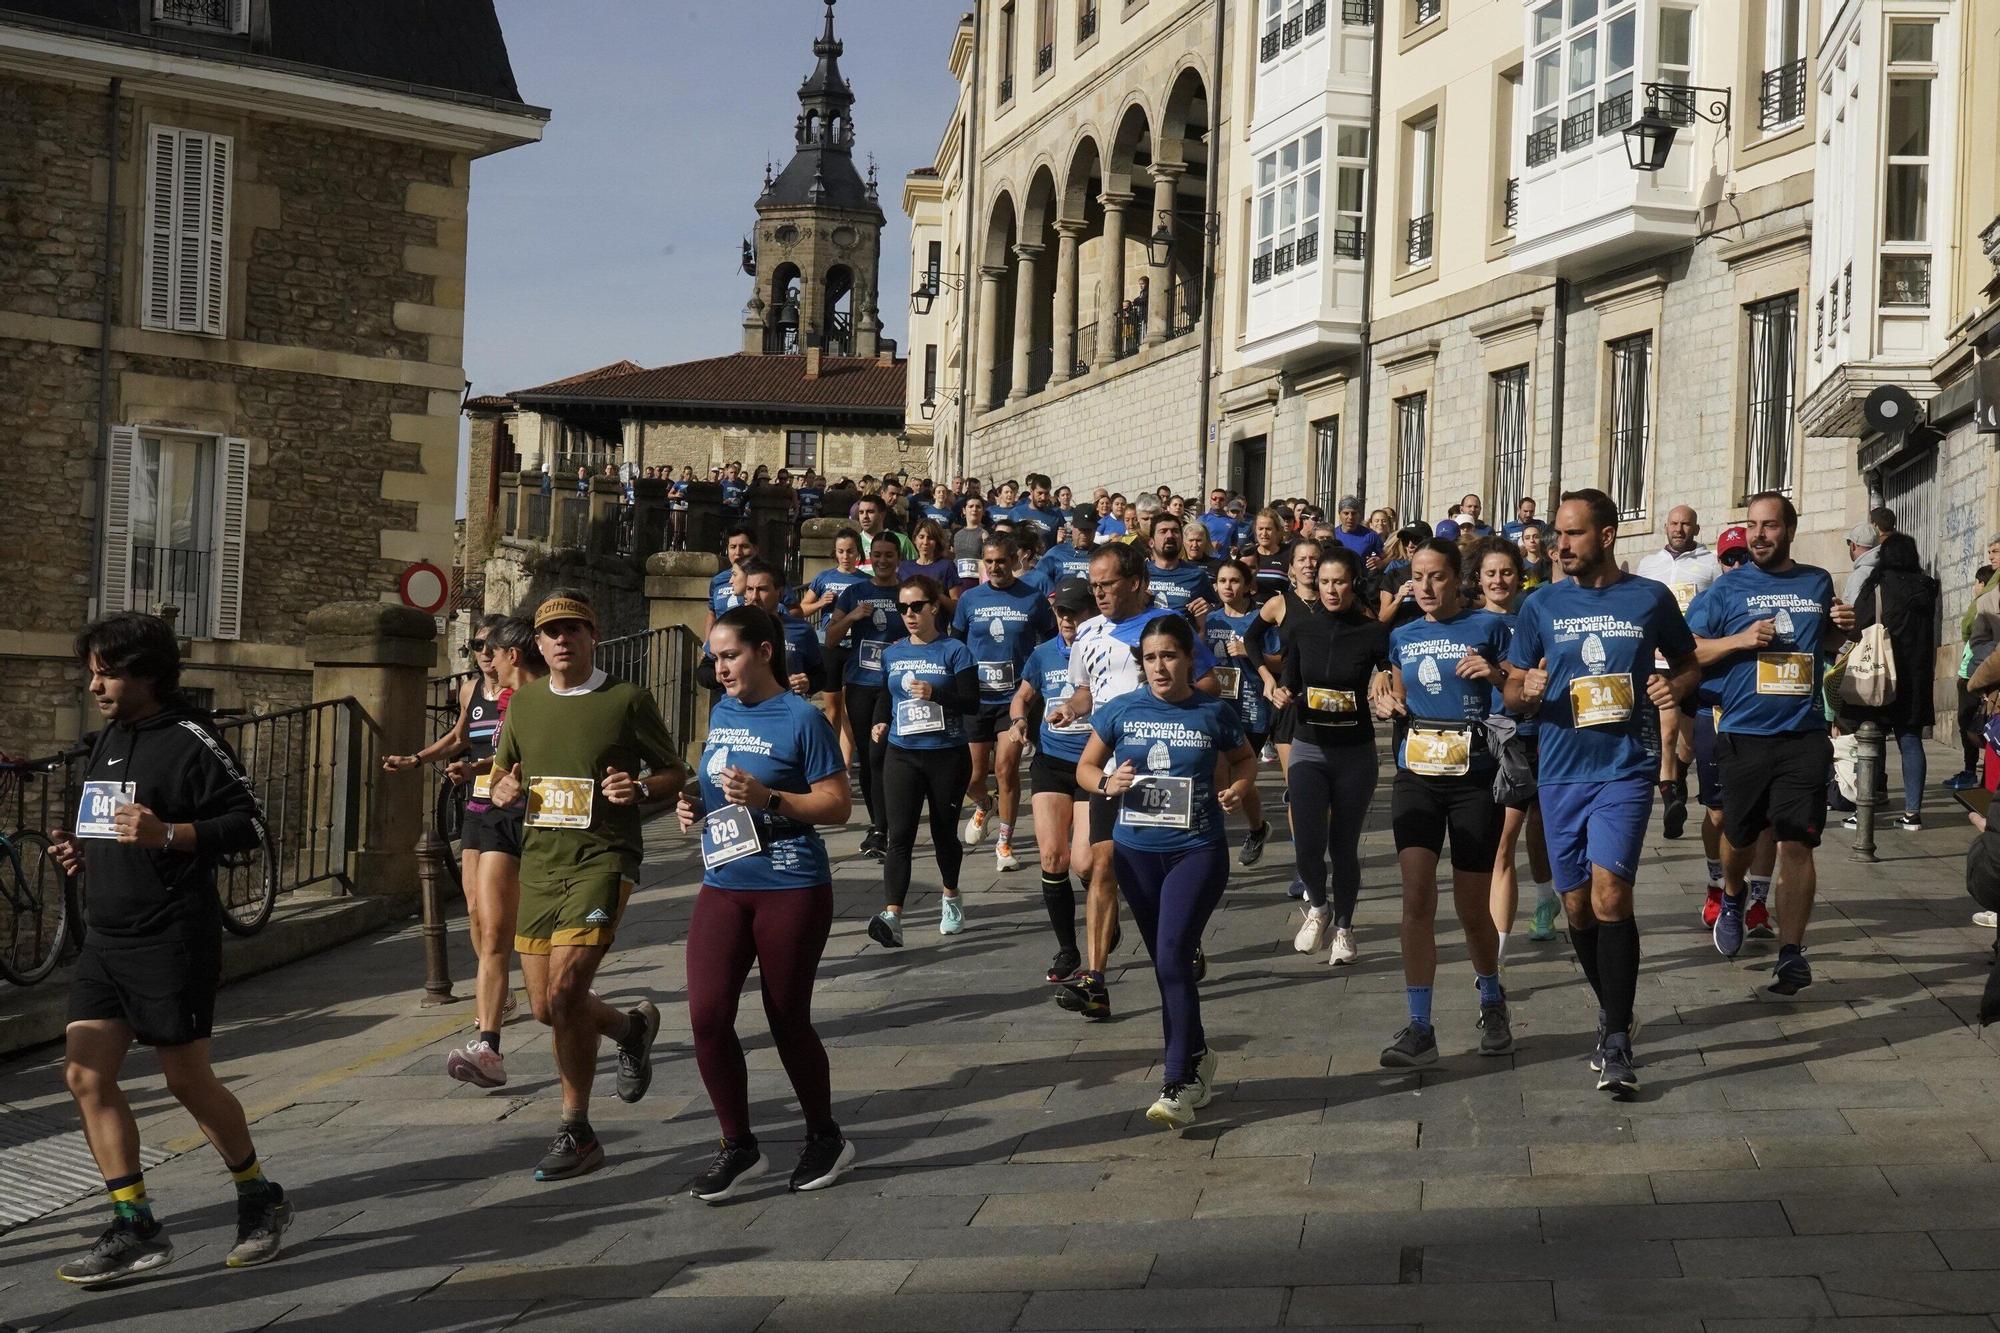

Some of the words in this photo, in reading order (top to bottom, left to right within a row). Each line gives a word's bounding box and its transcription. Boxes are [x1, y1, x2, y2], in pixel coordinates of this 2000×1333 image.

[1760, 599, 1815, 608] ALMENDRA
[1564, 615, 1614, 625] CONQUISTA
[1566, 621, 1633, 633] ALMENDRA
[1602, 630, 1644, 639] KONKISTA
[1408, 639, 1450, 650] CONQUISTA
[1408, 644, 1467, 657] ALMENDRA
[985, 669, 1003, 680] 739
[1775, 663, 1799, 678] 179
[1590, 686, 1614, 705] 34
[908, 706, 931, 720] 953
[1134, 722, 1185, 730] CONQUISTA
[713, 728, 750, 736] CONQUISTA
[1135, 729, 1202, 740] ALMENDRA
[709, 735, 761, 746] ALMENDRA
[1170, 740, 1211, 748] KONKISTA
[732, 745, 771, 756] KONKISTA
[1427, 741, 1448, 759] 29
[544, 790, 574, 808] 391
[1141, 788, 1172, 808] 782
[92, 795, 115, 816] 841
[710, 819, 739, 844] 829
